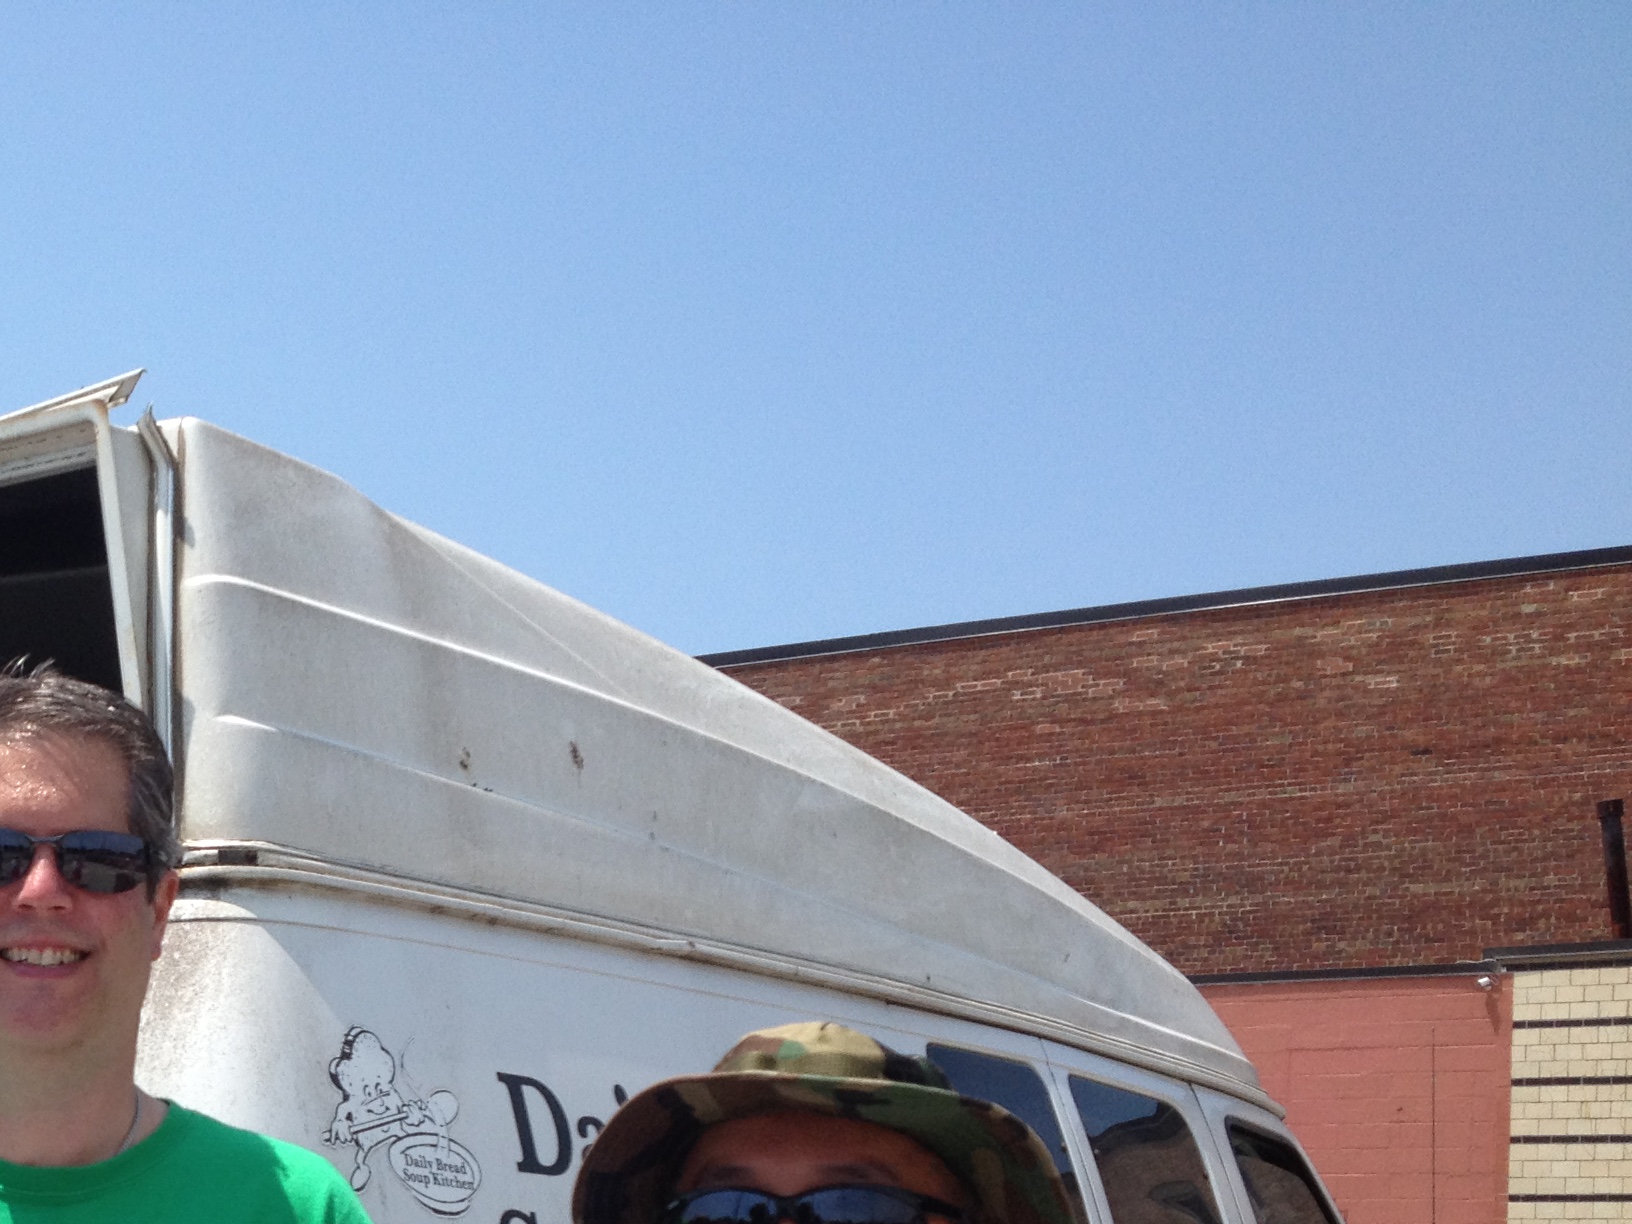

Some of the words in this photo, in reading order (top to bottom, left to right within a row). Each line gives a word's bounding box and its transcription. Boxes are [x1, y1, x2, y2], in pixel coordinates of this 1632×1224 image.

[404, 1153, 433, 1173] Daily
[435, 1158, 467, 1175] Bread
[403, 1168, 430, 1189] Soup
[430, 1171, 475, 1191] Kitchen
